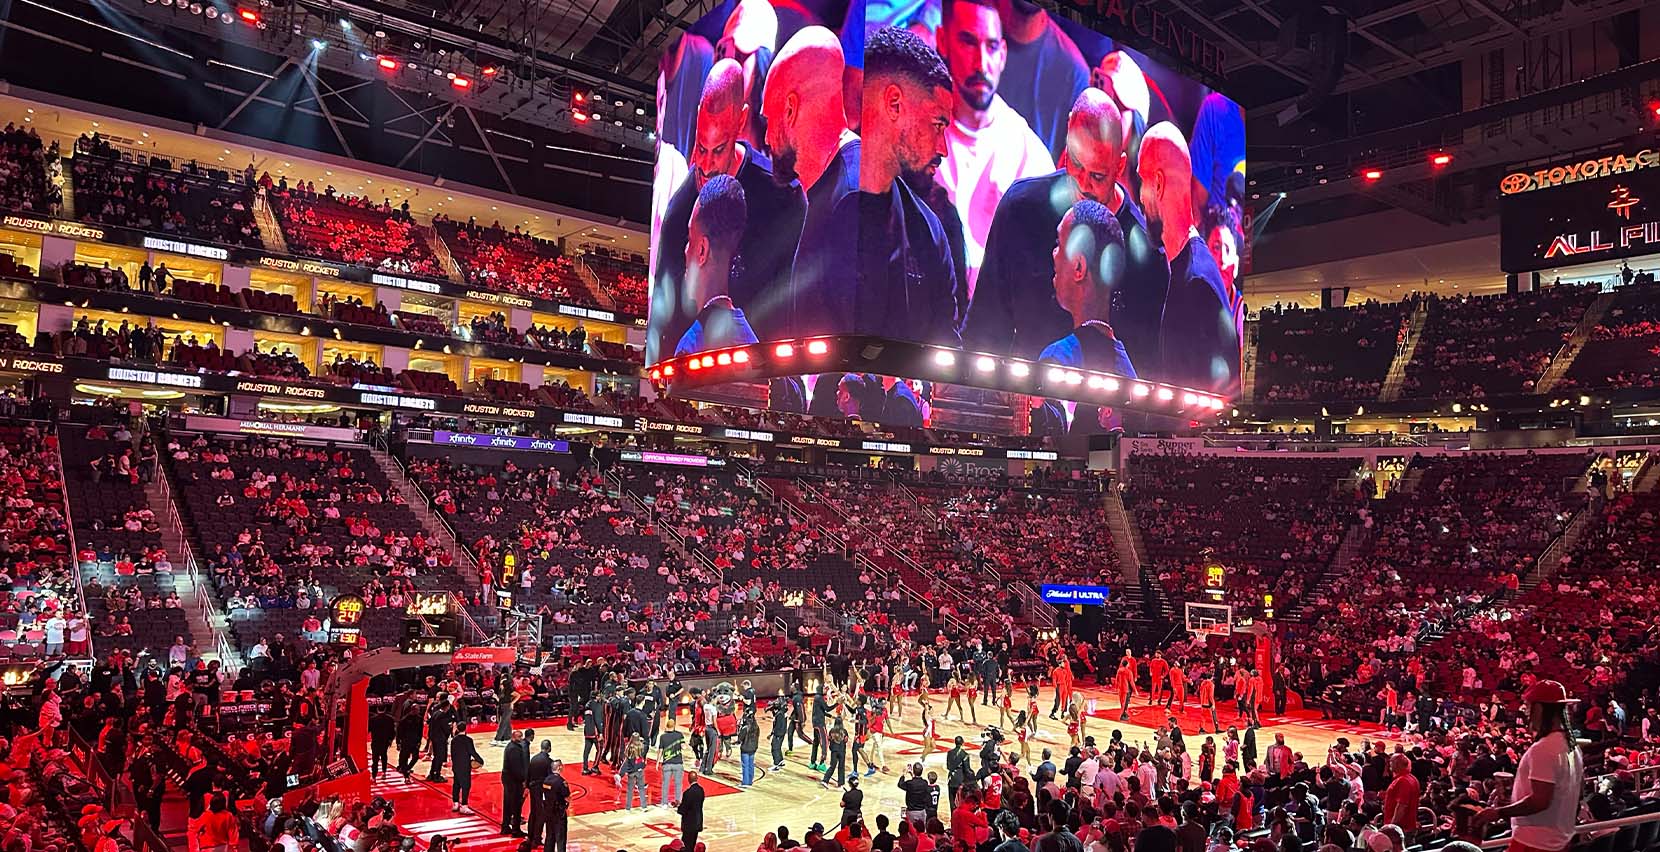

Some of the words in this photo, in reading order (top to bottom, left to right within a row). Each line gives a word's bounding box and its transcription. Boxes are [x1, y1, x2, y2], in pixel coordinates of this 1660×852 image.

[1132, 2, 1228, 80] CENTER
[1535, 154, 1630, 186] TOYOTA
[4, 216, 53, 231] HOUSTON
[59, 224, 104, 239] ROCKETS
[144, 236, 187, 253] HOUSTON
[188, 243, 228, 260] ROCKETS
[1544, 230, 1614, 259] ALL
[260, 256, 299, 270] HOUSTON
[303, 263, 339, 276] ROCKETS
[466, 290, 499, 302] HOUSTON
[503, 296, 532, 307] ROCKETS
[12, 359, 64, 373] ROCKETS
[109, 367, 156, 383] HOUSTON
[157, 372, 201, 388] ROCKETS
[237, 381, 281, 394] HOUSTON
[285, 386, 325, 398] ROCKETS
[464, 404, 500, 414] HOUSTON
[502, 408, 535, 418] ROCKETS
[240, 421, 273, 430] MEMORIAL
[273, 423, 305, 432] HERMANN
[676, 425, 702, 434] ROCKETS
[449, 433, 476, 445] xfinity
[491, 437, 516, 448] xfinity
[531, 440, 555, 451] xfinity
[791, 436, 815, 445] HOUSTON
[817, 438, 840, 447] ROCKETS
[1157, 440, 1195, 450] Supper
[930, 447, 955, 455] HOUSTON
[958, 448, 983, 456] ROCKETS
[964, 462, 1005, 478] Frost
[1207, 574, 1222, 587] 24
[1079, 591, 1105, 599] ULTRA
[338, 611, 356, 623] 24
[227, 735, 236, 743] G
[246, 733, 255, 741] G
[265, 732, 273, 740] G
[284, 730, 292, 738] G
